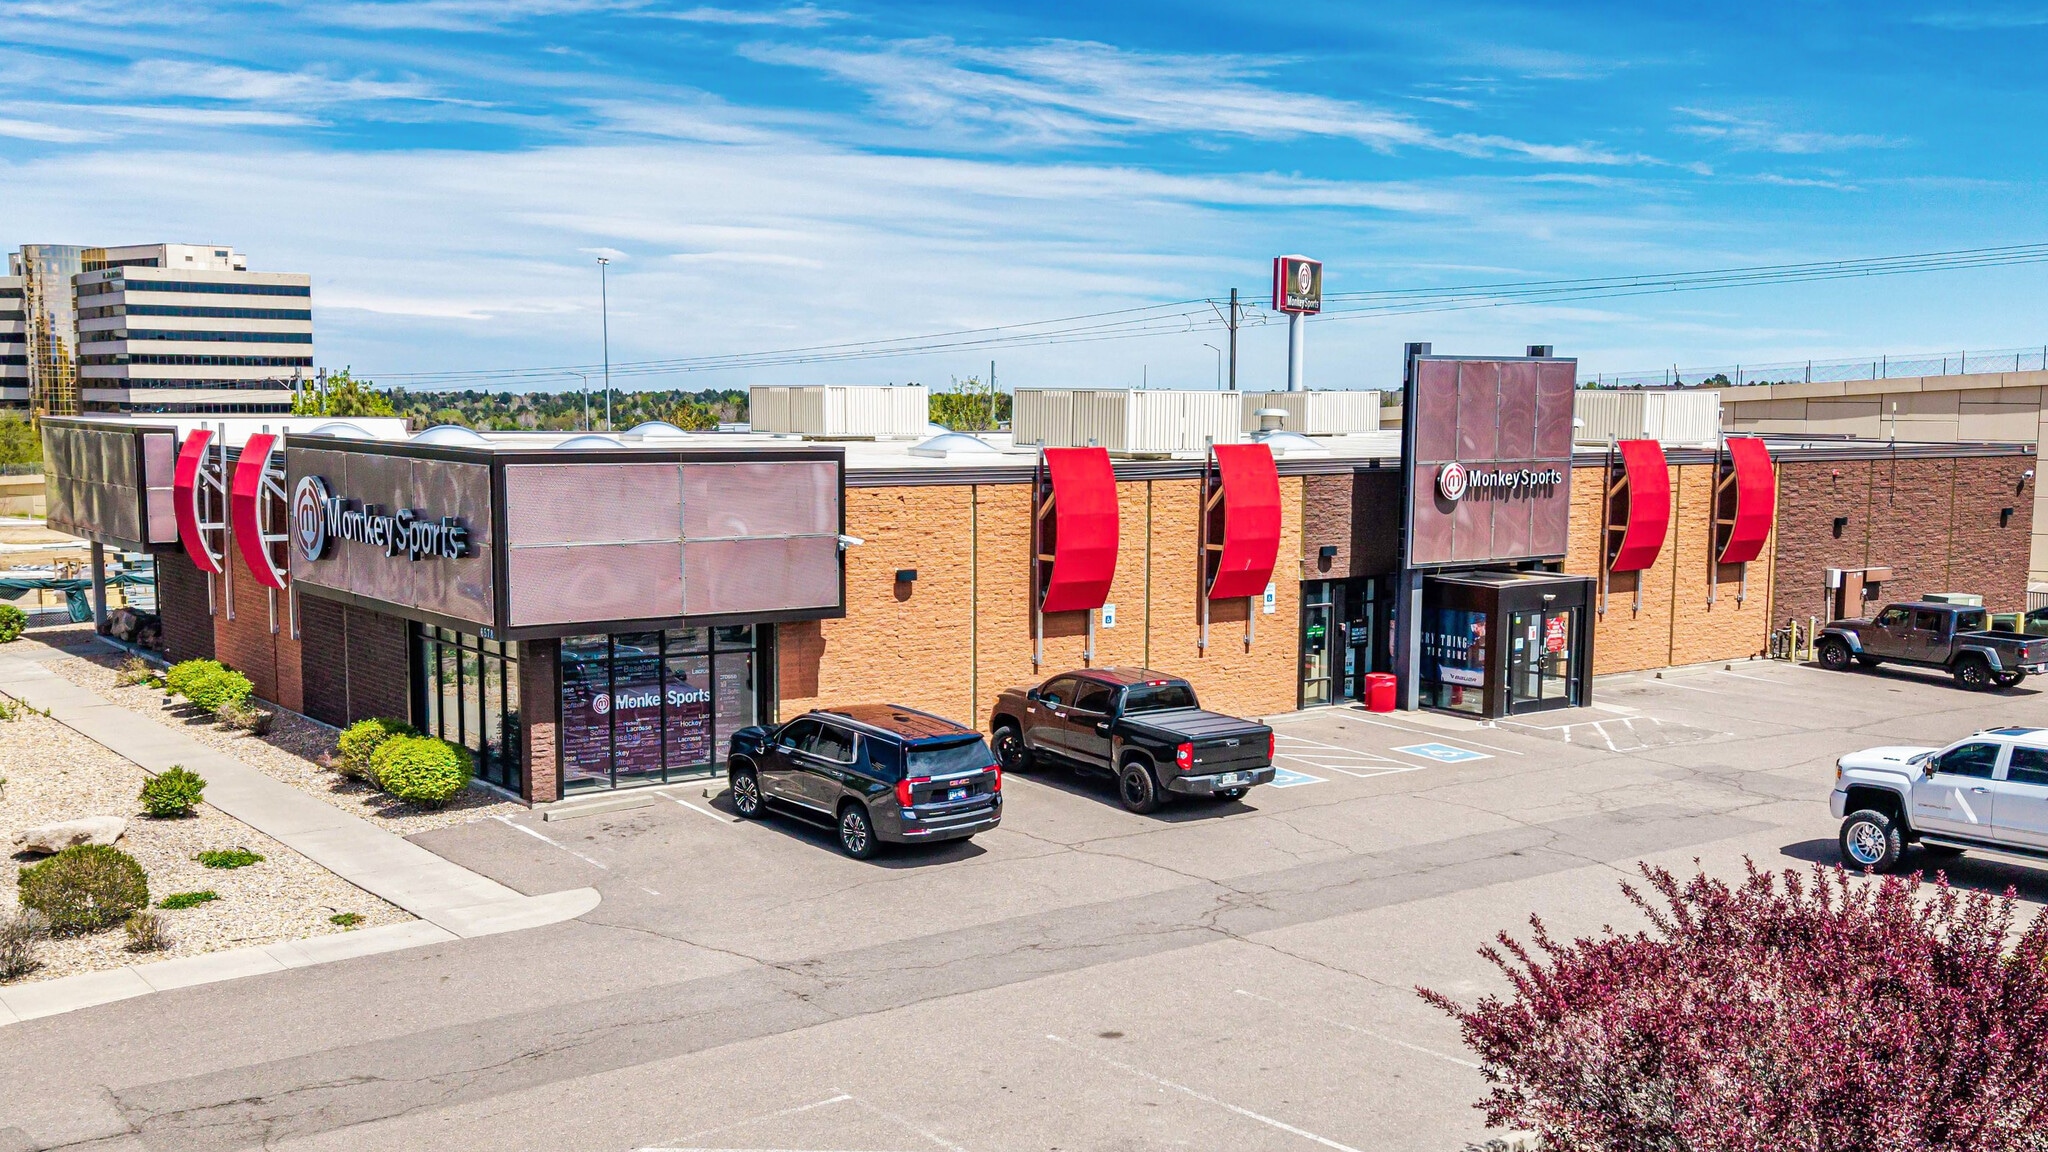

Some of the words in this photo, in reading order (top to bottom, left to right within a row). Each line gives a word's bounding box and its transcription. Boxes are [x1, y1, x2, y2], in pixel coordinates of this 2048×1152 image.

[1287, 295, 1319, 309] MonkeySports
[1469, 468, 1562, 489] MonkeySports
[327, 498, 461, 561] MonkeySports
[615, 689, 710, 710] MonkeSports
[680, 719, 702, 728] Hockey
[589, 728, 610, 737] Softba
[626, 725, 652, 733] Lacrosse
[615, 732, 641, 742] aseball
[678, 735, 702, 743] Lacrosse
[949, 778, 970, 787] GMC
